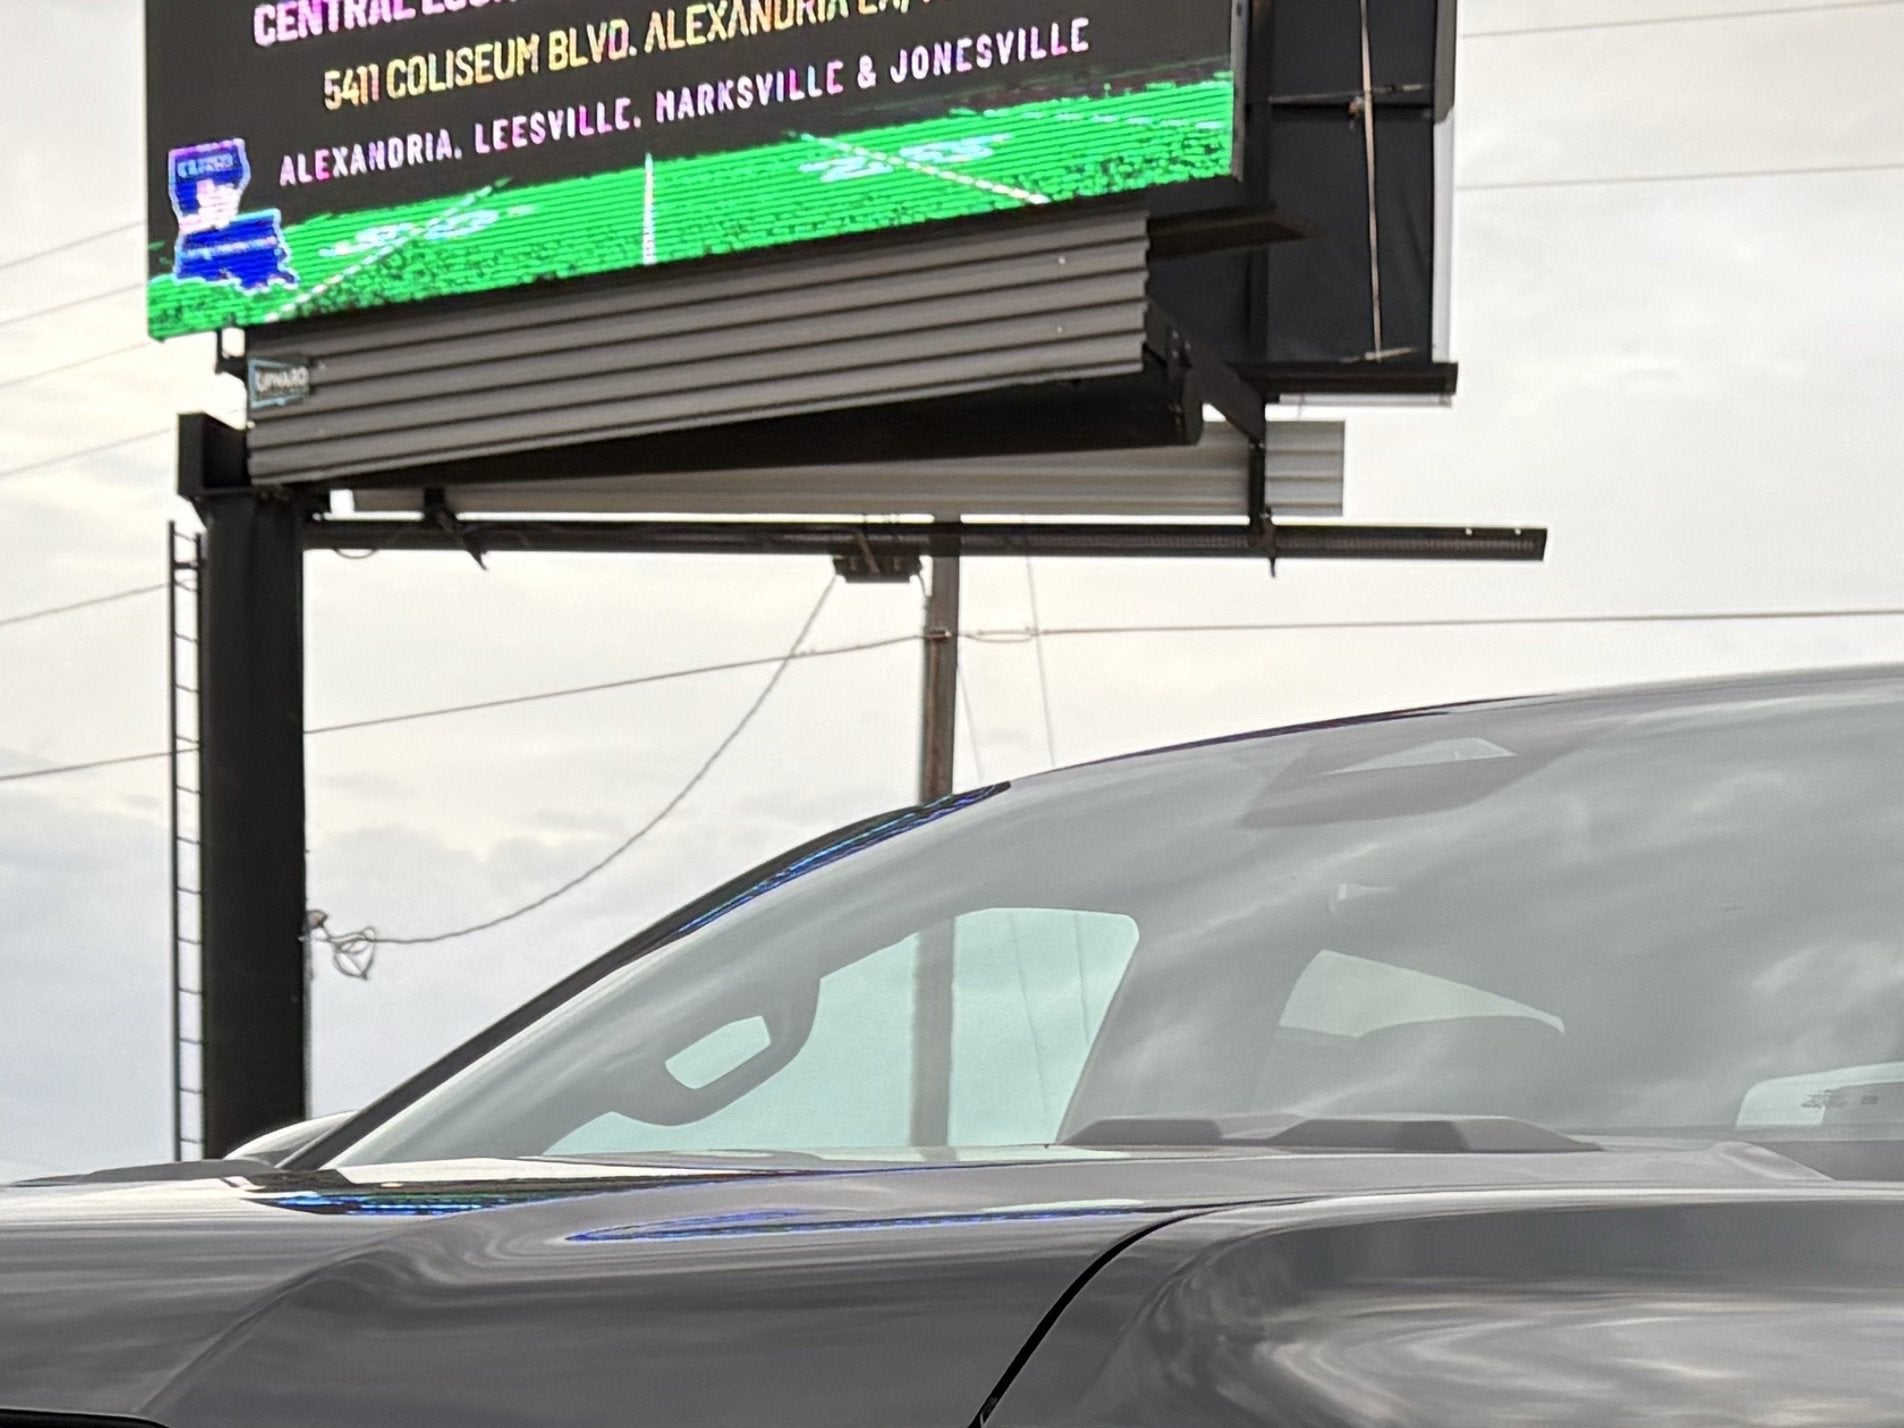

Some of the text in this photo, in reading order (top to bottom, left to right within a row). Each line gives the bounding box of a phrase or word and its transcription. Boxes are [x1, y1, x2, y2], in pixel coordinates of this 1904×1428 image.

[324, 63, 380, 111] 5411
[386, 33, 541, 100] COLISEUM
[547, 18, 638, 72] BLVD.
[655, 60, 844, 124] MARKSVILLE
[856, 54, 878, 90] &
[889, 17, 1091, 84] JONESVILLE
